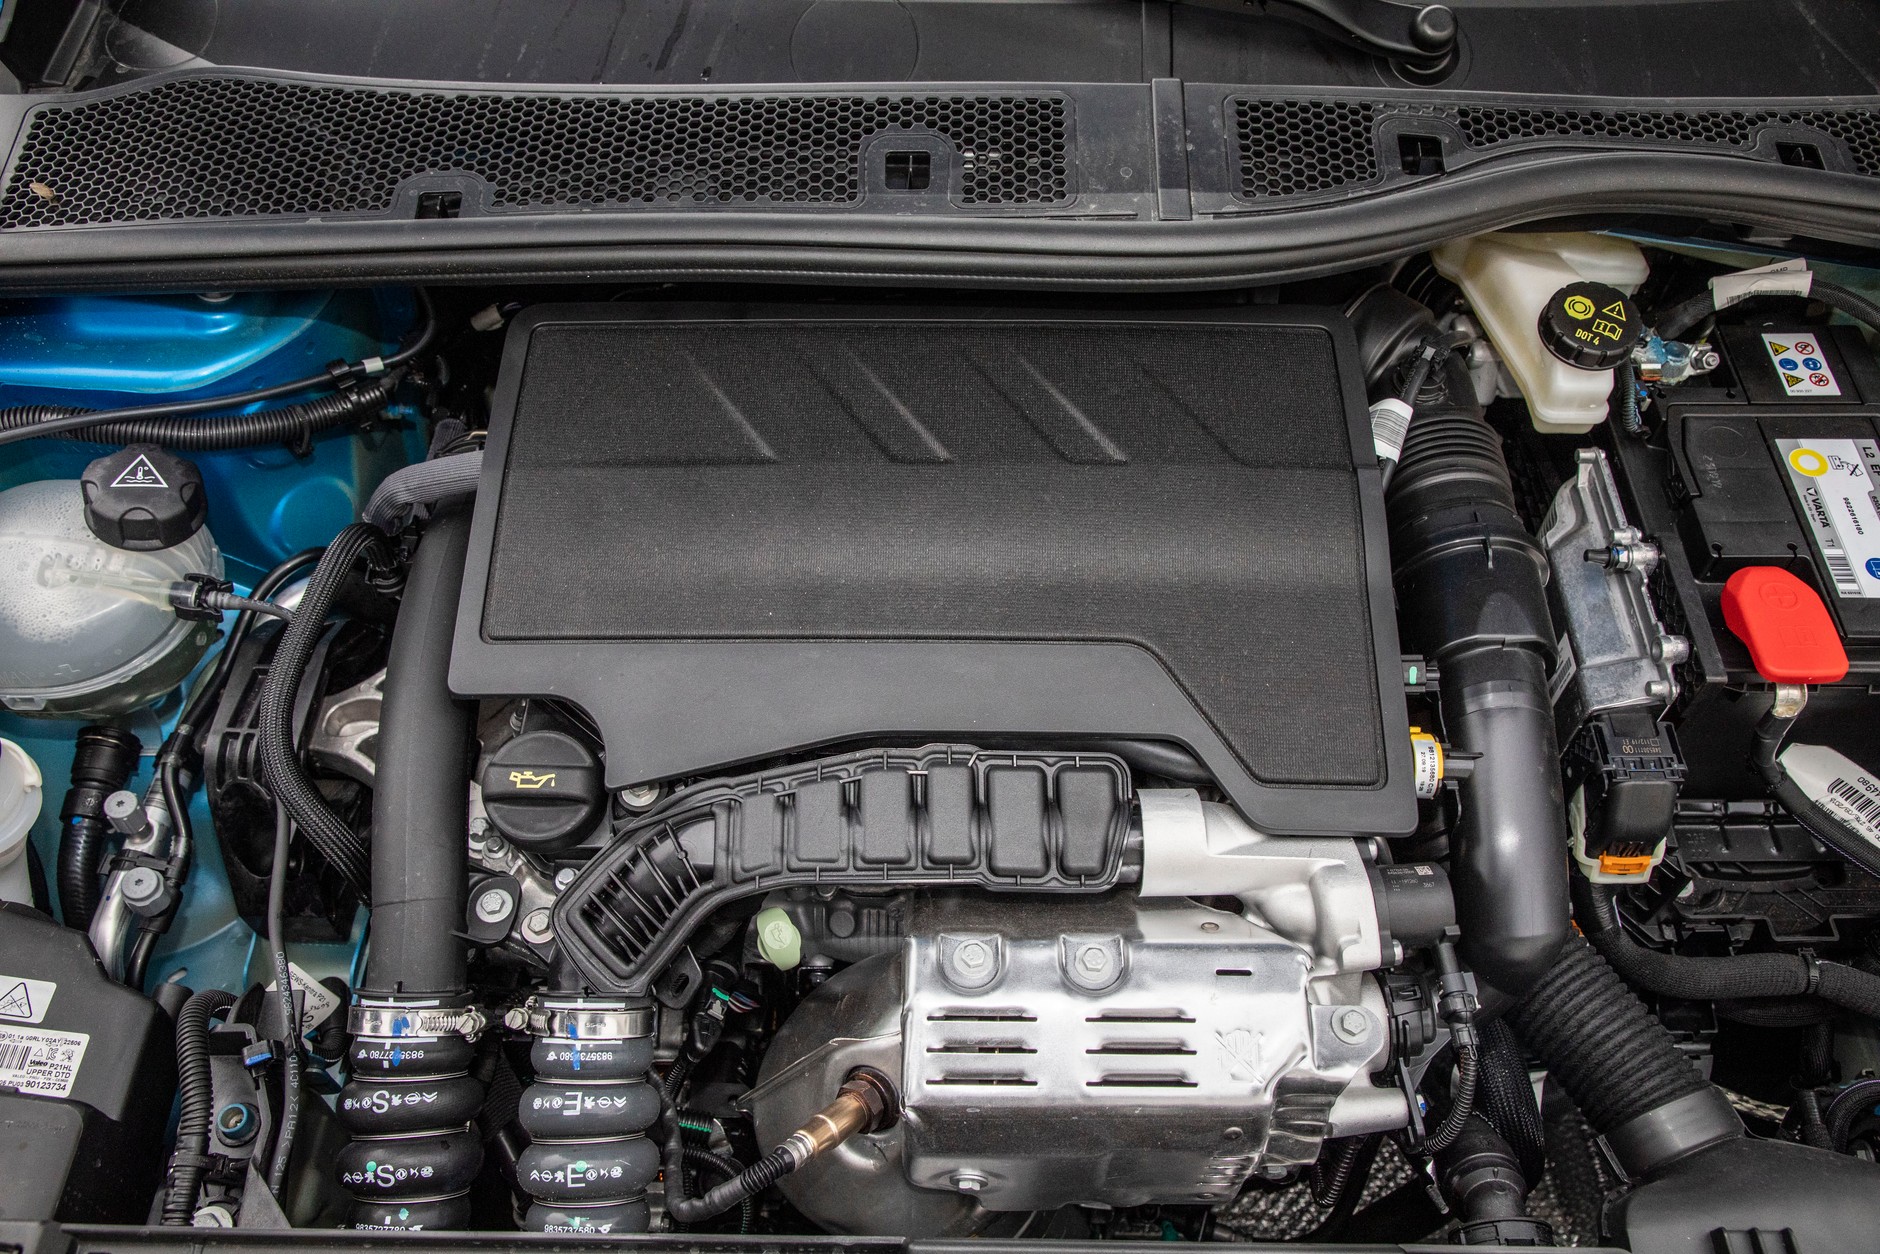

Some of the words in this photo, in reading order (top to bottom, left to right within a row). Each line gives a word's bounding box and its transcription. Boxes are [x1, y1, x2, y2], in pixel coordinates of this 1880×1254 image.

[1575, 328, 1594, 342] DOT
[1592, 336, 1600, 346] 4
[1862, 446, 1875, 459] L2
[1812, 497, 1829, 528] VARTA
[276, 951, 293, 1016] 9824346380
[369, 1050, 425, 1060] 983527780
[26, 1068, 53, 1076] UPPER
[54, 1070, 71, 1079] DTD
[49, 1062, 73, 1072] P21HL
[25, 1079, 67, 1091] 90123734
[372, 1090, 390, 1114] S
[562, 1091, 583, 1116] E
[376, 1164, 396, 1188] S
[566, 1163, 586, 1188] E
